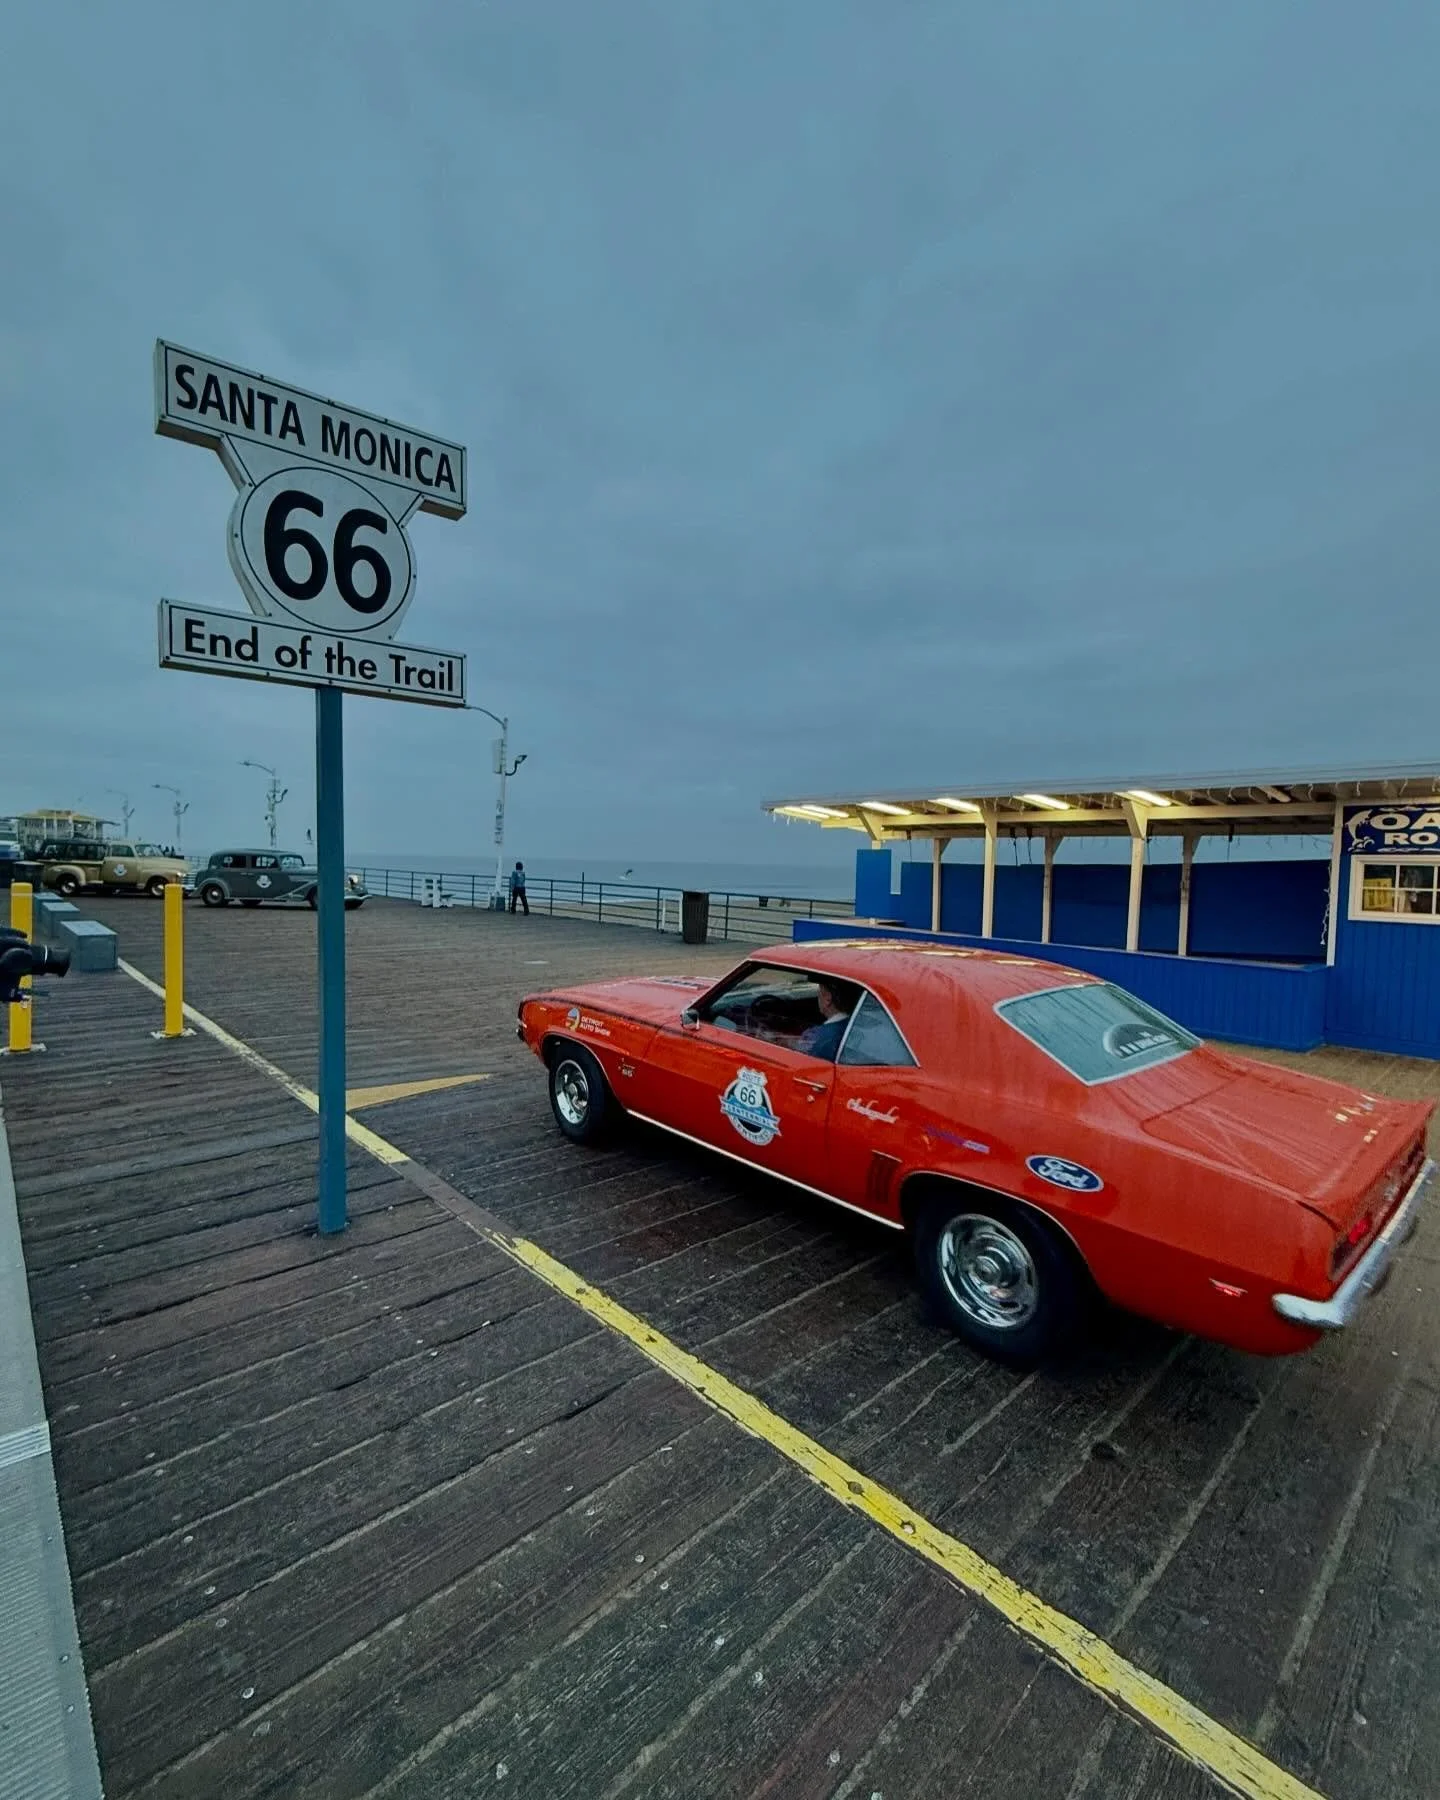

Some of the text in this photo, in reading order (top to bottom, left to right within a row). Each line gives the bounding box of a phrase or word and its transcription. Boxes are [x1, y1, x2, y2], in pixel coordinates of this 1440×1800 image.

[174, 363, 457, 493] SANTA MONICA
[263, 489, 392, 614] 66
[184, 617, 454, 692] End of the Trail
[740, 1086, 757, 1105] 66
[1038, 1159, 1089, 1188] Ford
